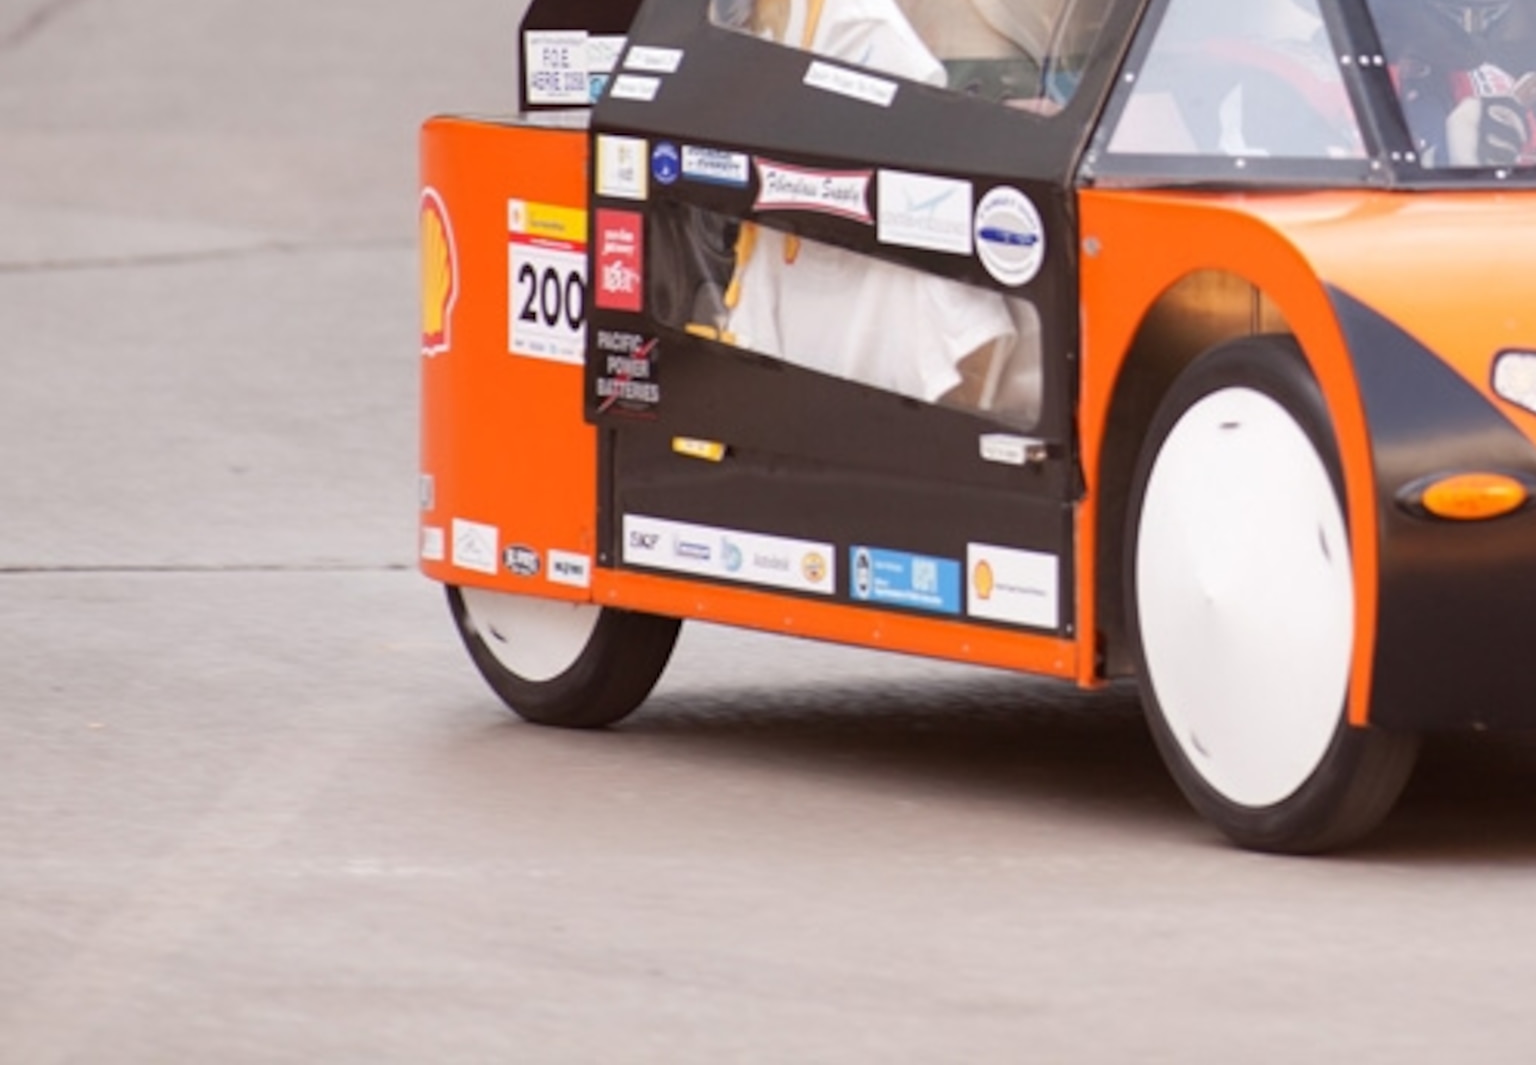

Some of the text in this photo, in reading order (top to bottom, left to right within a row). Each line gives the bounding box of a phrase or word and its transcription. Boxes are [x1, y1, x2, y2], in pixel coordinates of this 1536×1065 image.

[518, 262, 587, 332] 200
[597, 329, 644, 354] PACIFIC
[606, 355, 650, 378] POWER
[596, 376, 659, 403] BATTERIES
